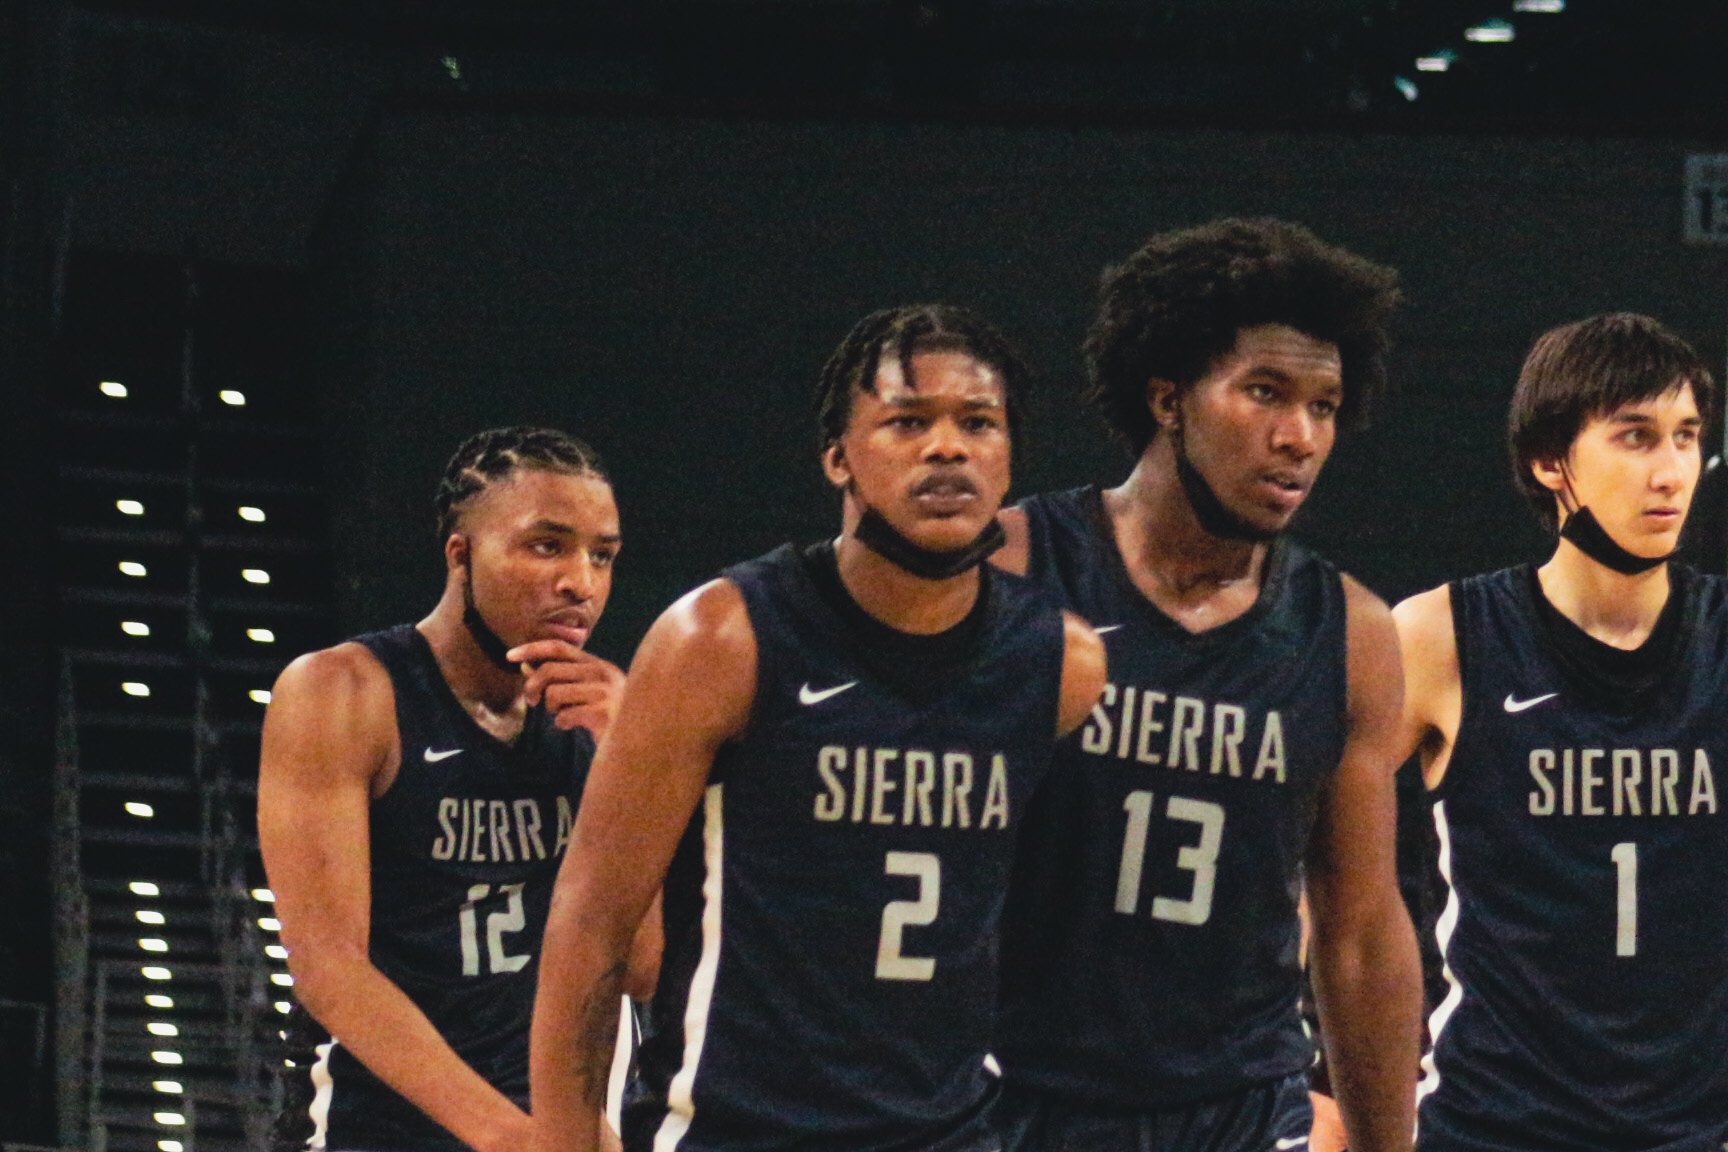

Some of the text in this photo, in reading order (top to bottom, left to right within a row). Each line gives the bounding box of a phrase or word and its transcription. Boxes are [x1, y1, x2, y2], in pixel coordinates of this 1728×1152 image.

[1081, 682, 1287, 784] SIERRA
[1528, 748, 1718, 816] SIERRA
[431, 795, 574, 863] SIERRA
[813, 745, 1010, 830] SIERRA
[1113, 789, 1226, 926] 13
[1610, 841, 1638, 957] 1
[458, 881, 532, 977] 12
[874, 851, 941, 982] 2
